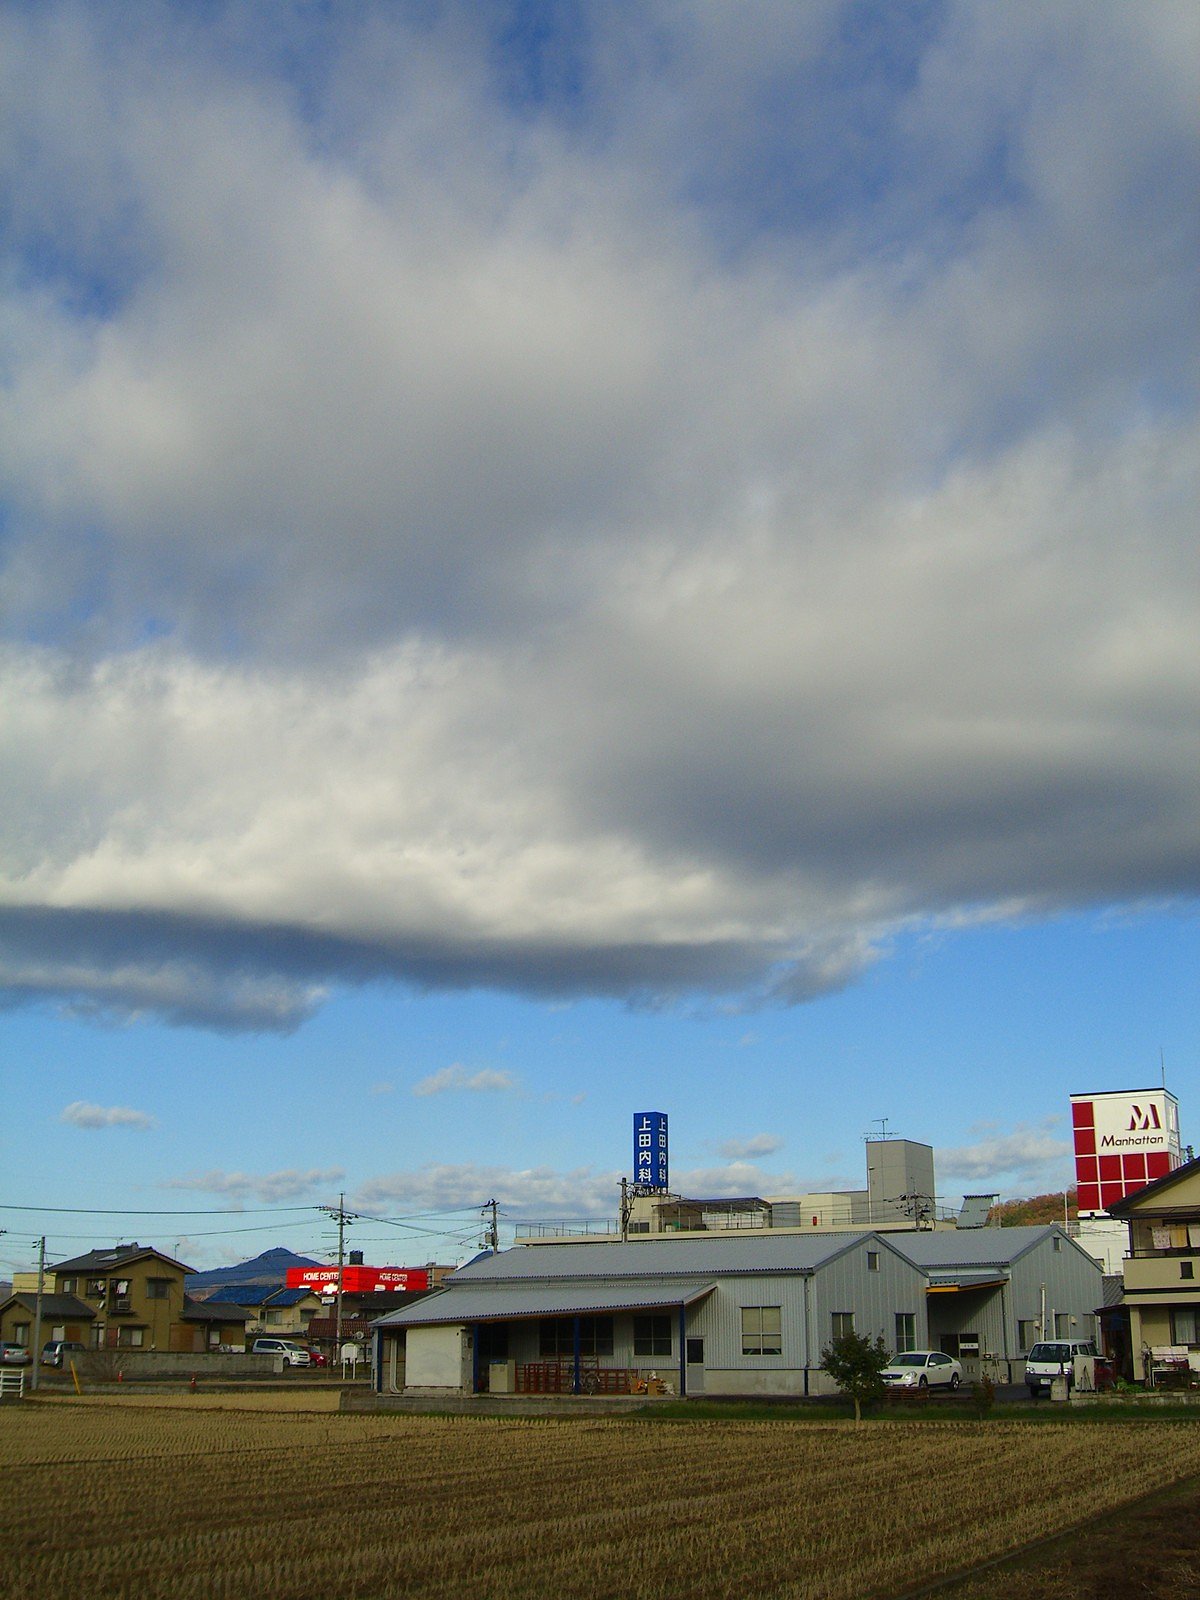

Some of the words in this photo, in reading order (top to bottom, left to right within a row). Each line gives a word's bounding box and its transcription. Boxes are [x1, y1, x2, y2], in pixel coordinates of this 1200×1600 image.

[1101, 1134, 1164, 1147] Manhattan
[638, 1116, 652, 1182] 上田内科
[658, 1117, 666, 1182] 上田内科
[303, 1272, 320, 1281] HOME
[320, 1271, 340, 1281] CENTE
[379, 1272, 391, 1281] HOME
[392, 1273, 408, 1282] CENTER
